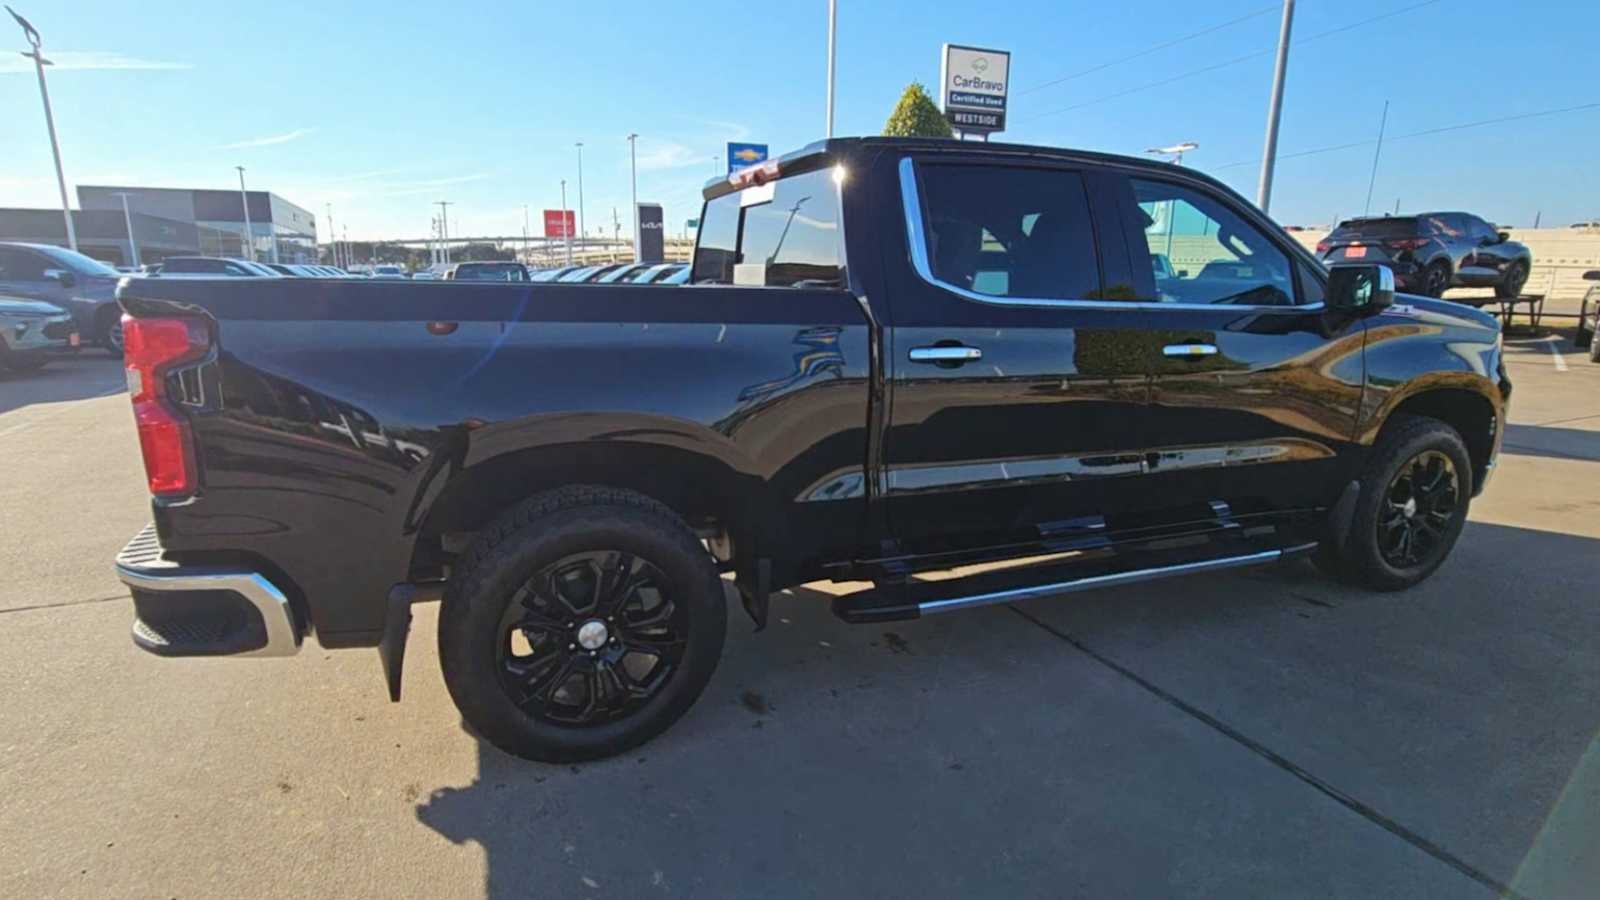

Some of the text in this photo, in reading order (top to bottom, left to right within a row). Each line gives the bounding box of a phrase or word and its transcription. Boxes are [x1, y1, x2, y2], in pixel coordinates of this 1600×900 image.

[953, 75, 1004, 91] CarBravo
[952, 94, 1002, 105] Certified Used
[955, 113, 997, 125] WESTSIDE
